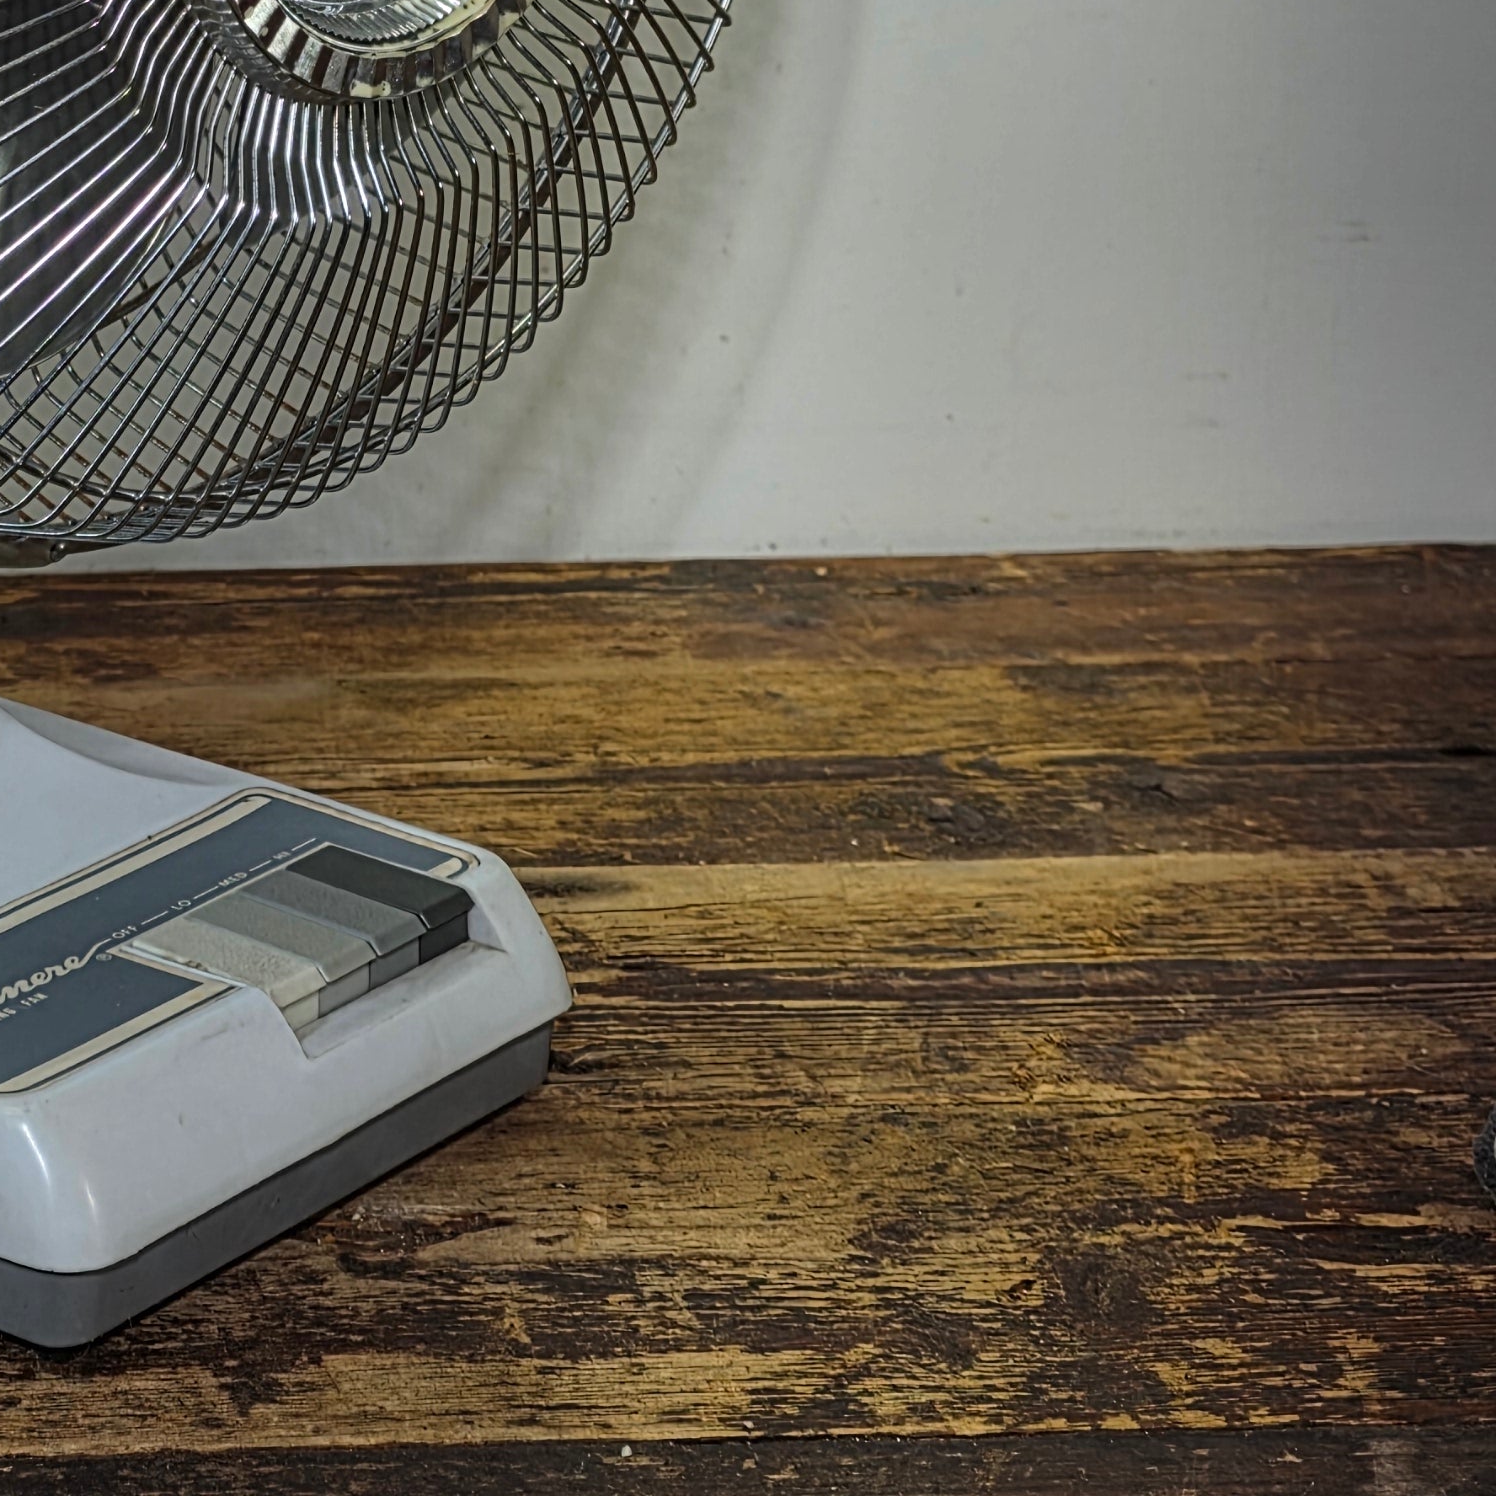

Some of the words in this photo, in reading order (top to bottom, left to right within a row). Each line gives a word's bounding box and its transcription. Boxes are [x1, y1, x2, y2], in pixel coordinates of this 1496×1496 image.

[111, 924, 138, 940] OFF
[170, 899, 192, 912] LO
[217, 871, 248, 888] MED
[20, 992, 49, 1008] FAN
